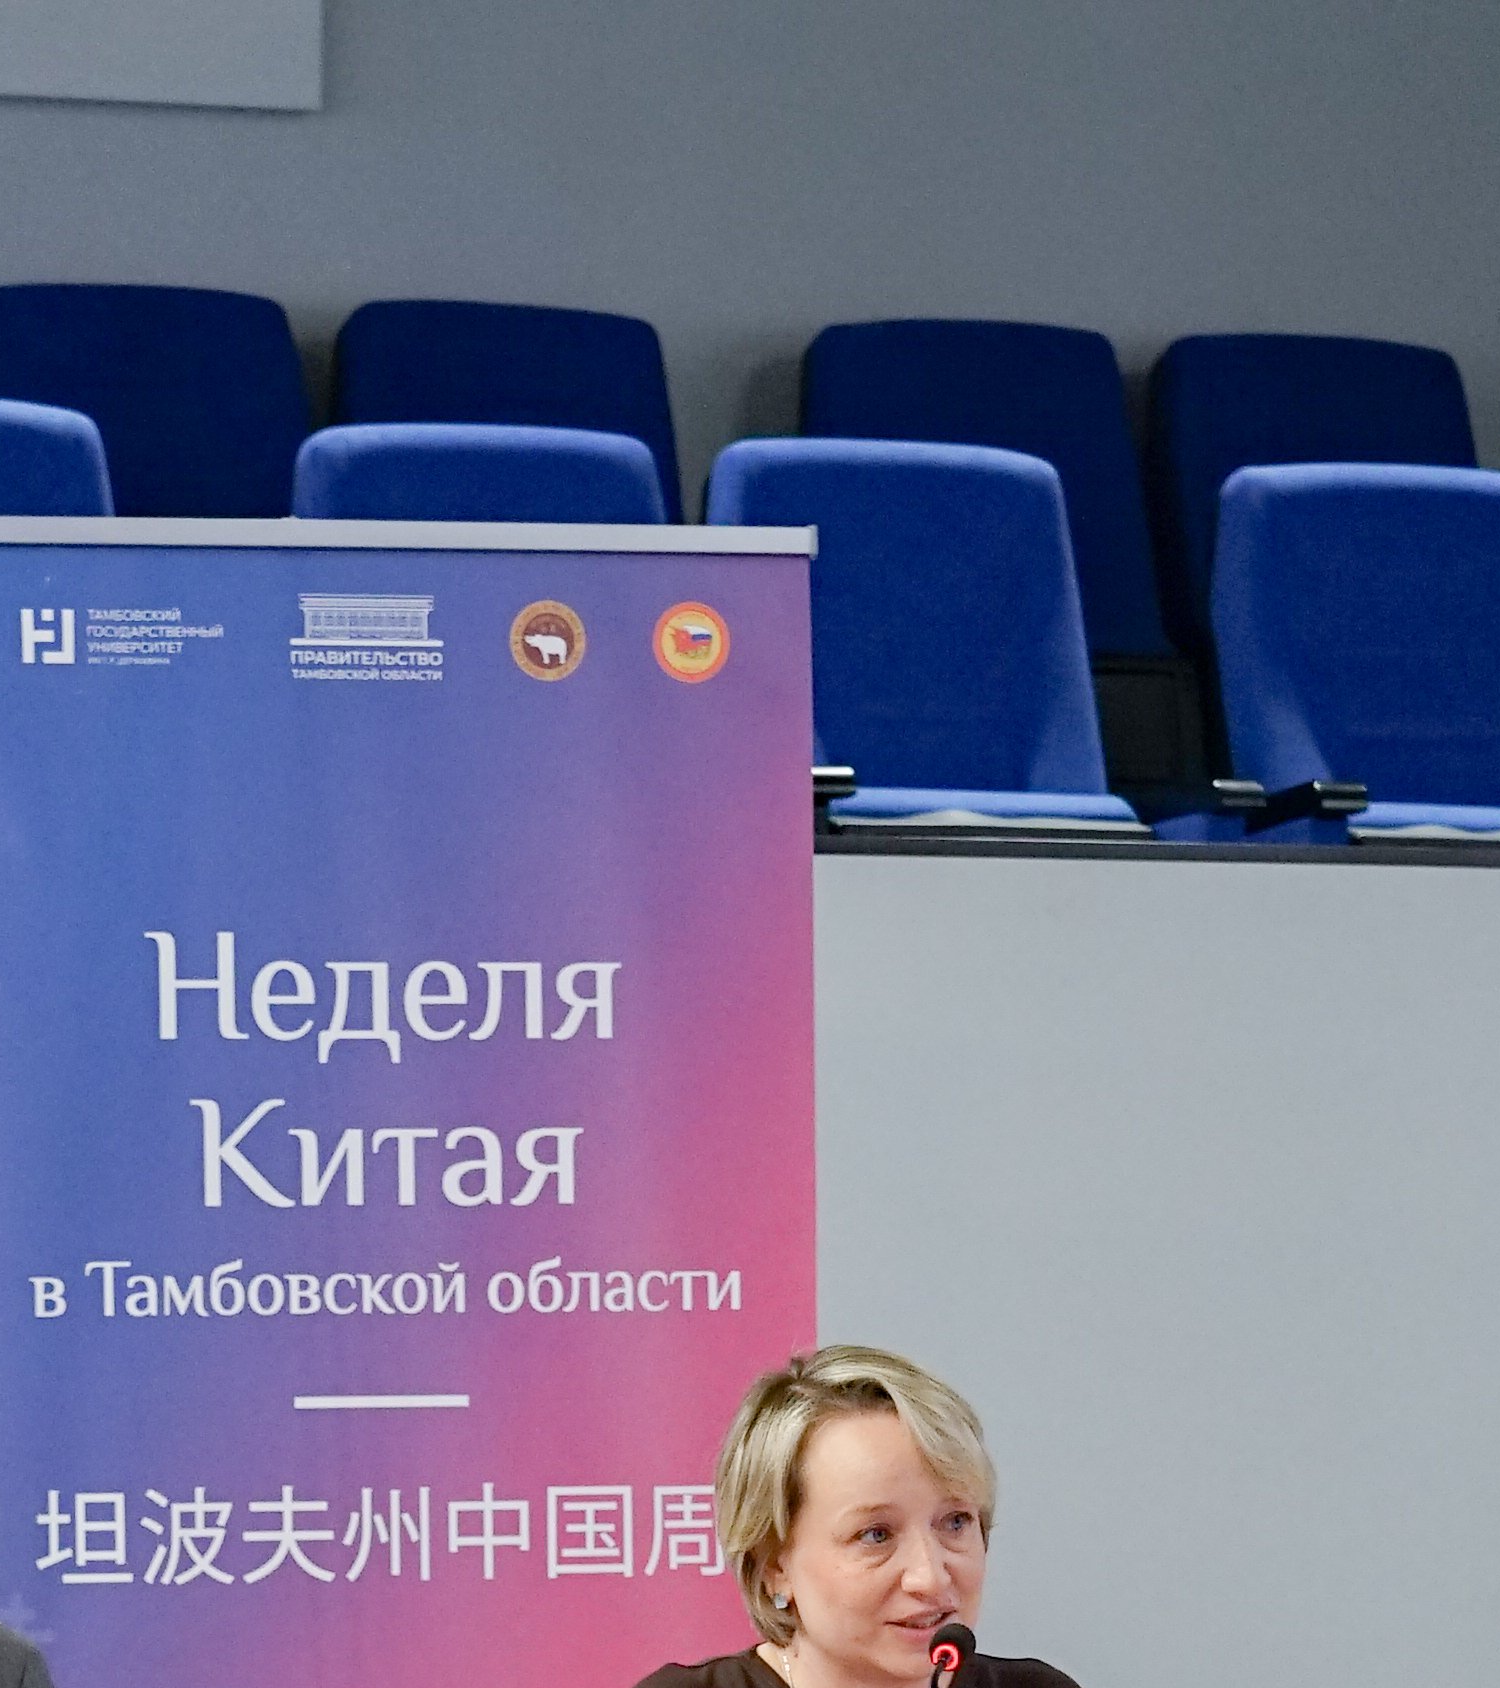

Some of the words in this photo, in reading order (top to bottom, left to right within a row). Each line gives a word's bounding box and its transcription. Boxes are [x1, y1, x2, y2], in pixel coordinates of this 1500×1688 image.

[290, 650, 443, 666] ПРАВИТЕЛЬСТВО
[144, 931, 622, 1064] Неделя
[190, 1098, 584, 1208] Китая
[29, 1275, 67, 1318] в
[85, 1259, 467, 1319] Тамбовской
[488, 1257, 743, 1314] области
[35, 1481, 727, 1587] 坦波夫州中国周
